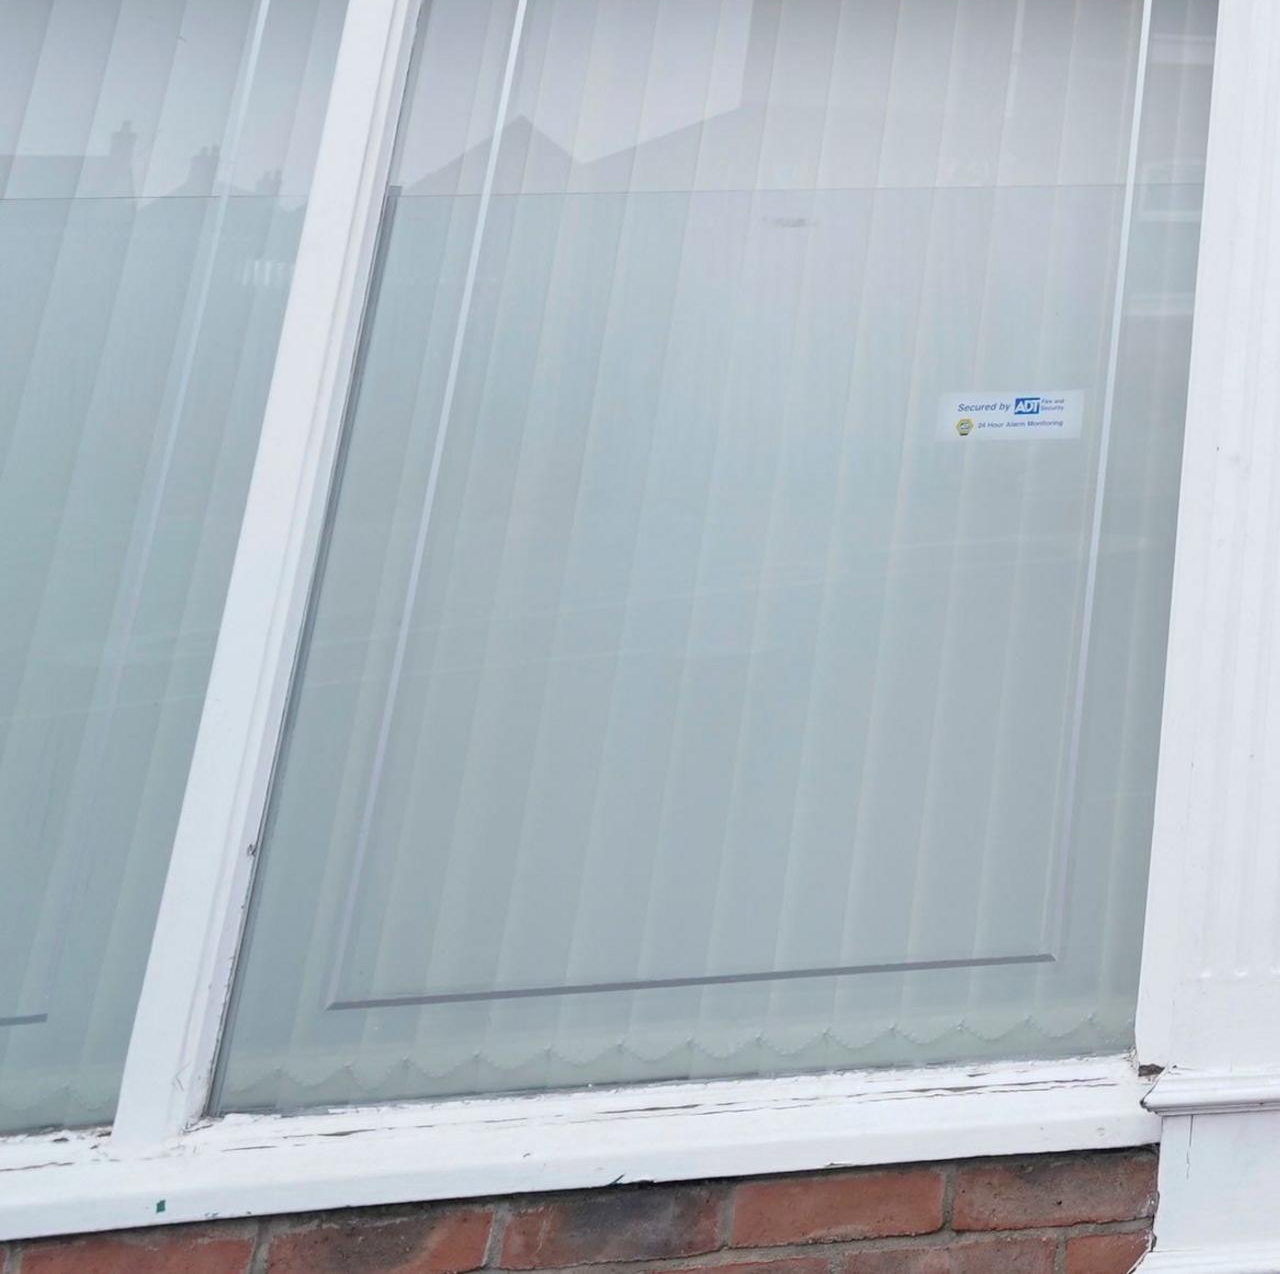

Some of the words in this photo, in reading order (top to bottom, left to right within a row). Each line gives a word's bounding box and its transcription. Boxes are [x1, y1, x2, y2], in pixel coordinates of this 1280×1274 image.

[957, 403, 996, 412] Secured
[999, 402, 1010, 412] by
[1015, 399, 1040, 413] ADT
[1027, 419, 1064, 427] Monitoring
